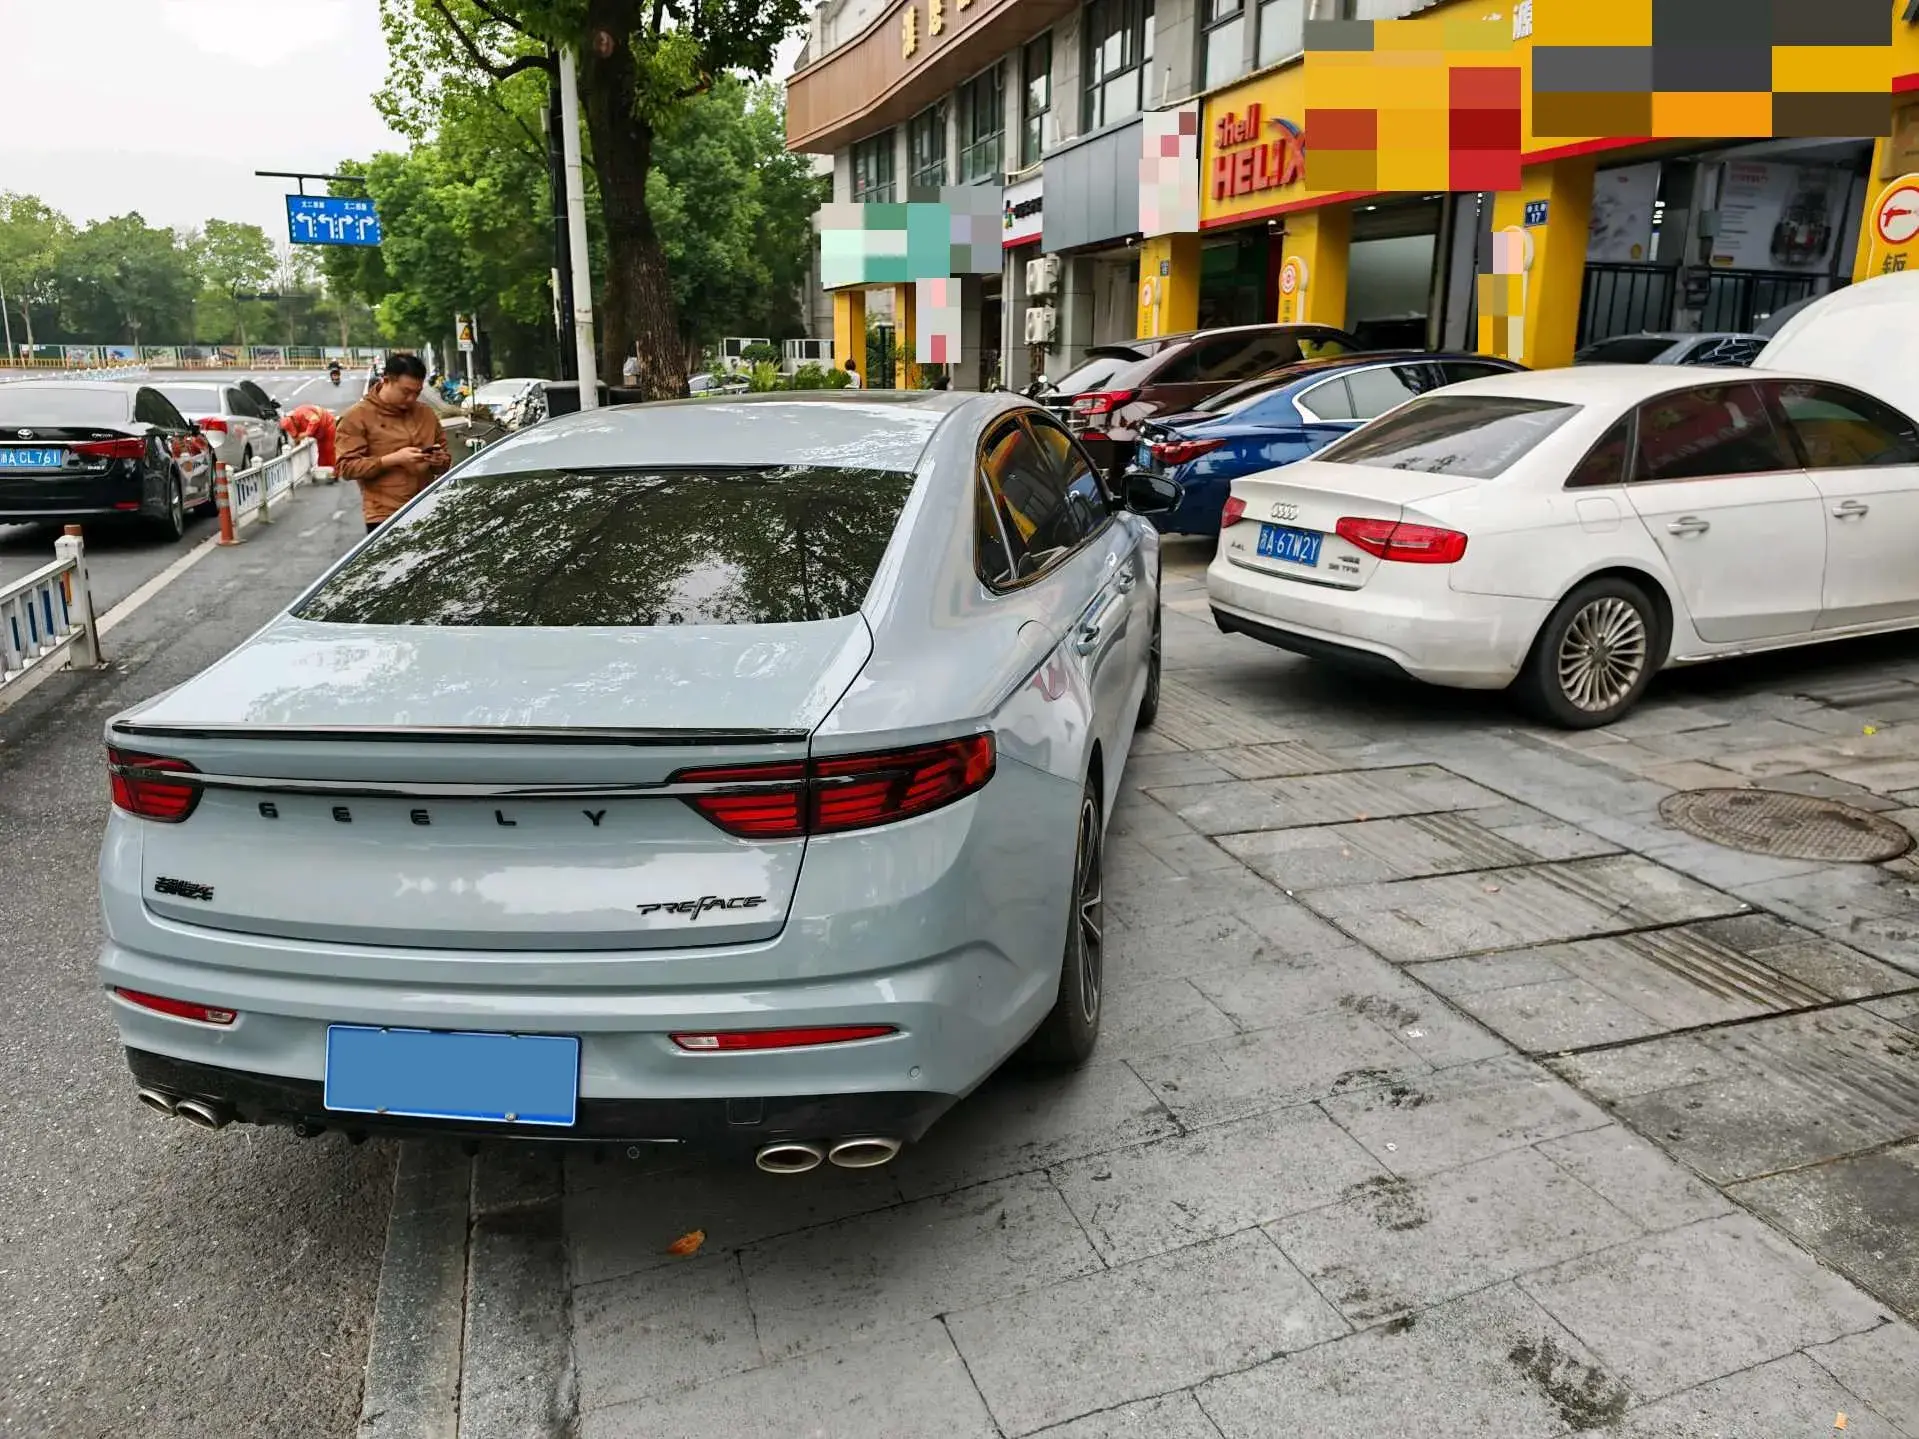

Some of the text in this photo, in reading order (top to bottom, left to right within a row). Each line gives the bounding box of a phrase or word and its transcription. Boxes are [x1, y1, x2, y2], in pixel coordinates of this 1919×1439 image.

[1215, 103, 1262, 150] Shell
[1212, 138, 1305, 201] HELIX
[258, 802, 606, 827] GEELY
[637, 896, 767, 920] PREFACE
